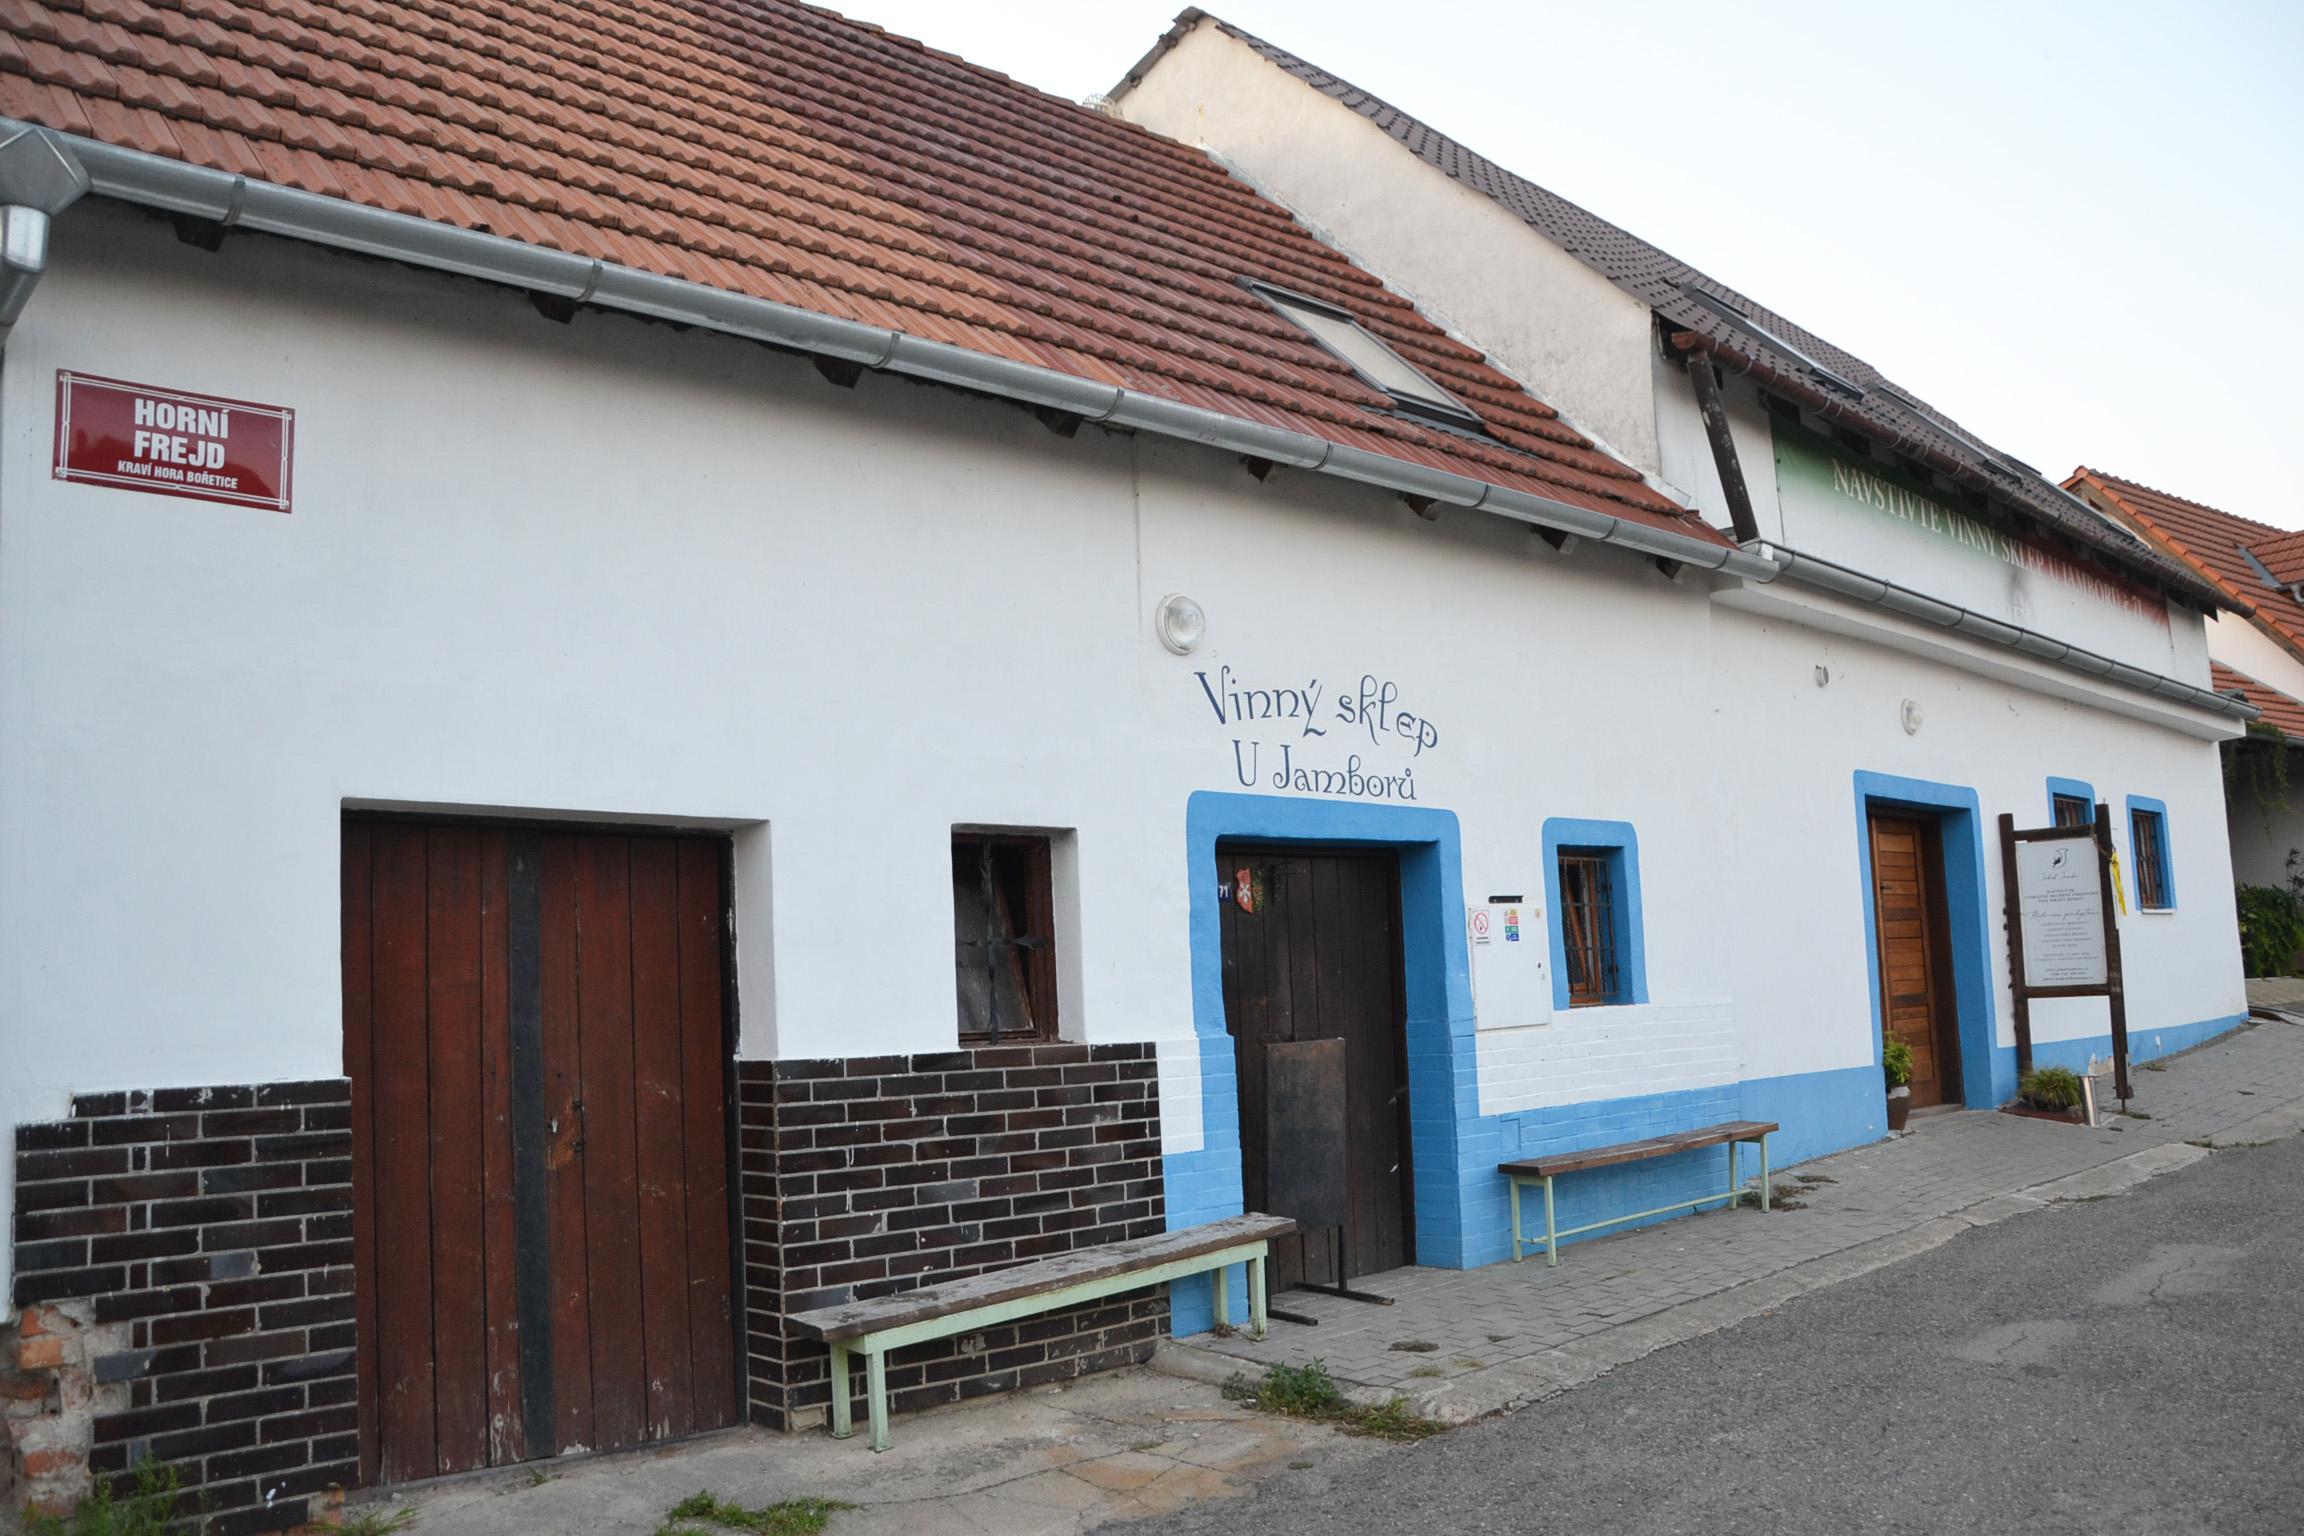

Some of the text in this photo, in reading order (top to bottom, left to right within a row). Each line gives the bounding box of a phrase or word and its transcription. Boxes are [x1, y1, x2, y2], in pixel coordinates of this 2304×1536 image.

[135, 398, 231, 439] HORNÍ
[133, 431, 225, 470] FREJD
[118, 460, 238, 489] KRAVÍ HORA BOŘETICE
[2001, 534, 2043, 576] SKLEP
[1194, 665, 1438, 757] Vinný sklep
[1232, 739, 1417, 800] U Jamborů
[1218, 885, 1228, 898] 71
